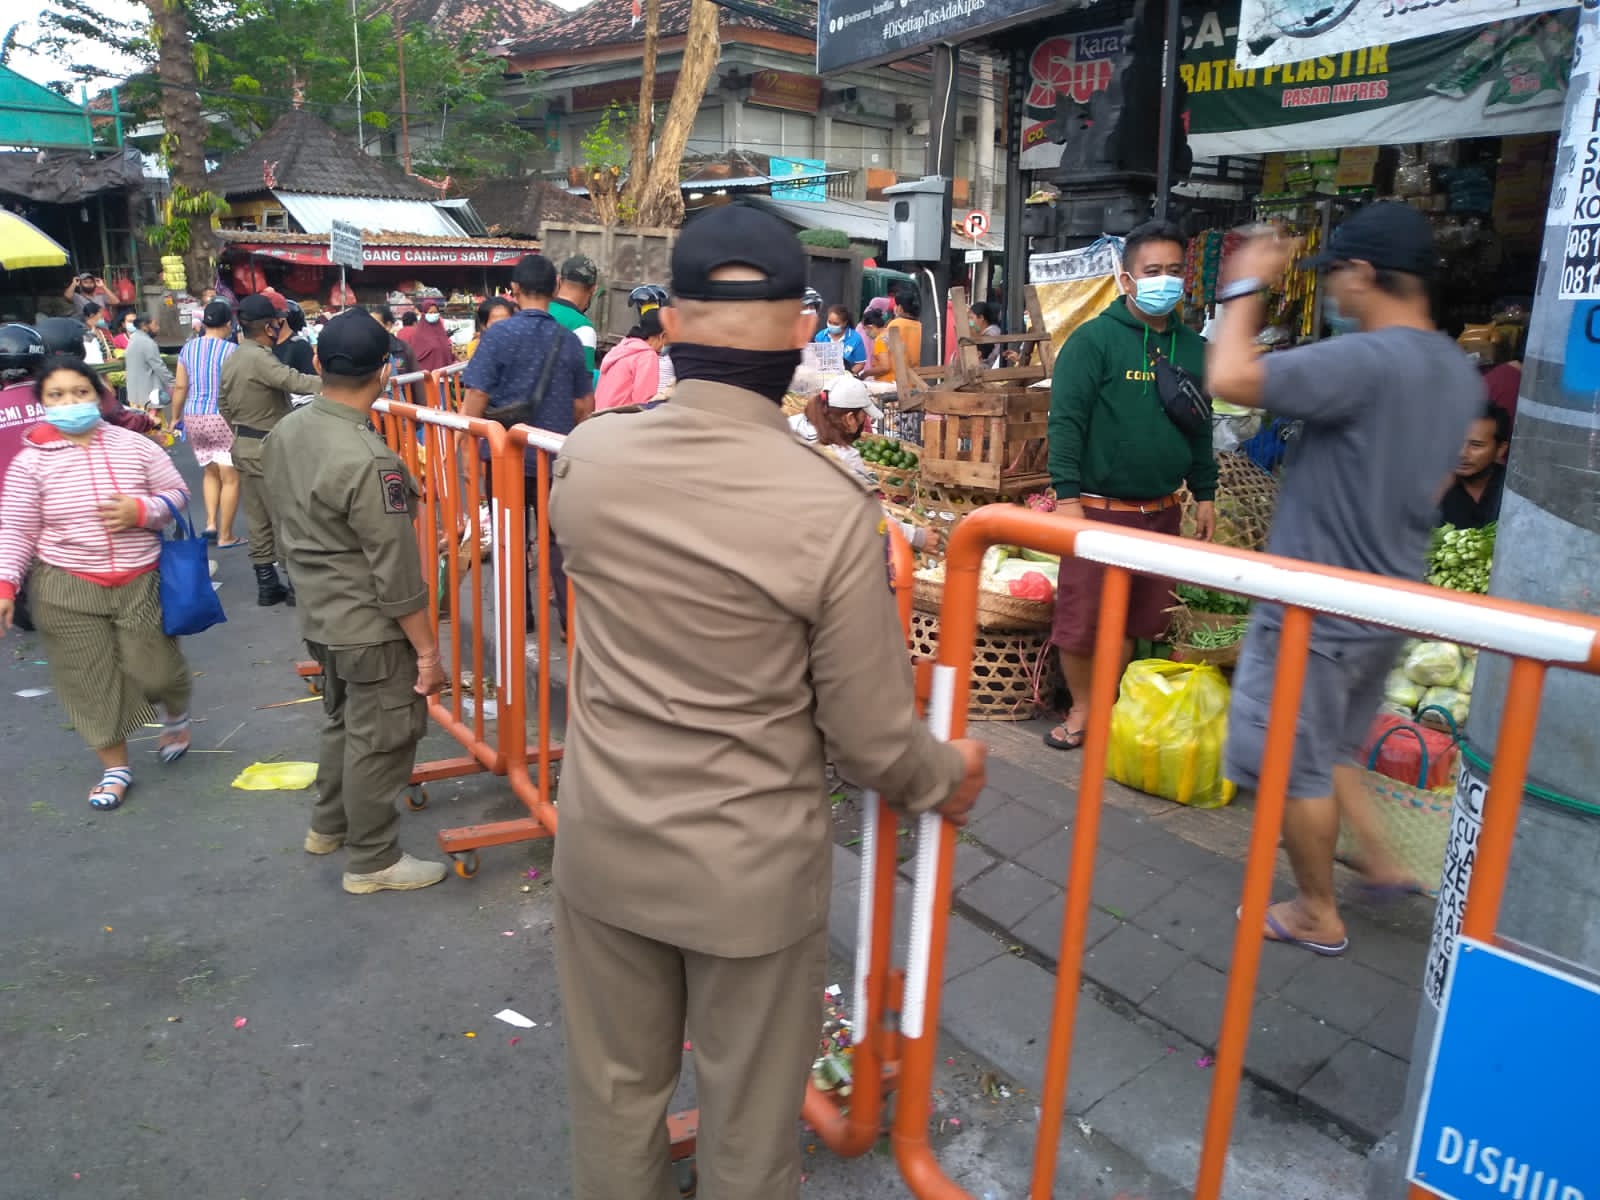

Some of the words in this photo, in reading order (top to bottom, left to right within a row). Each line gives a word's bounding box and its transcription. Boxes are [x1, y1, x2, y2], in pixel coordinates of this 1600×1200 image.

[1263, 44, 1390, 86] PLASTIK
[1281, 85, 1331, 108] PASAR
[1332, 79, 1388, 103] INPRES
[404, 249, 458, 262] CANANG
[460, 249, 489, 262] SARI
[25, 401, 46, 417] BA
